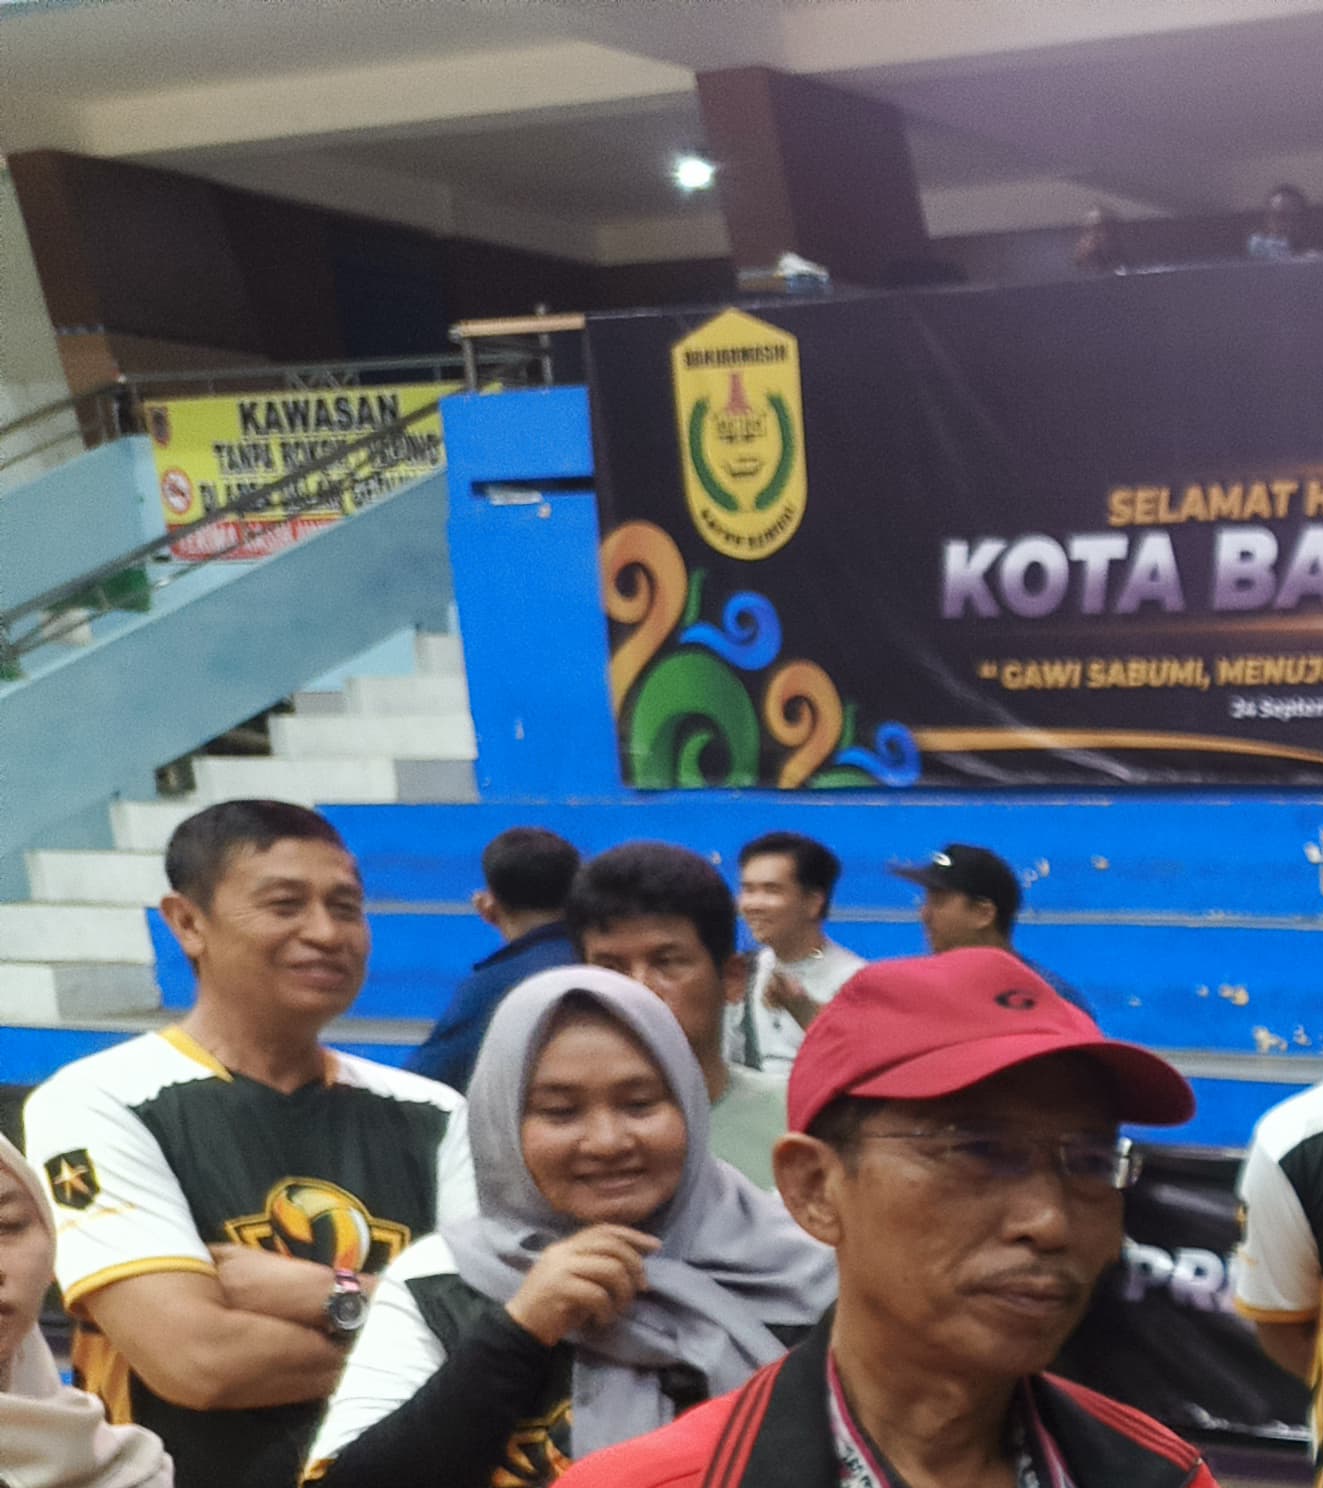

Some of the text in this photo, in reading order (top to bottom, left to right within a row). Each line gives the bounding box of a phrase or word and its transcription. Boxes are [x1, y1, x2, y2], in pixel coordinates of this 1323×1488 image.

[237, 393, 400, 434] KAWASAN
[1107, 482, 1298, 527] SELAMAT
[943, 529, 1185, 619] KOTA
[1003, 659, 1082, 690] GAWI
[1087, 655, 1211, 691] SABUMI,
